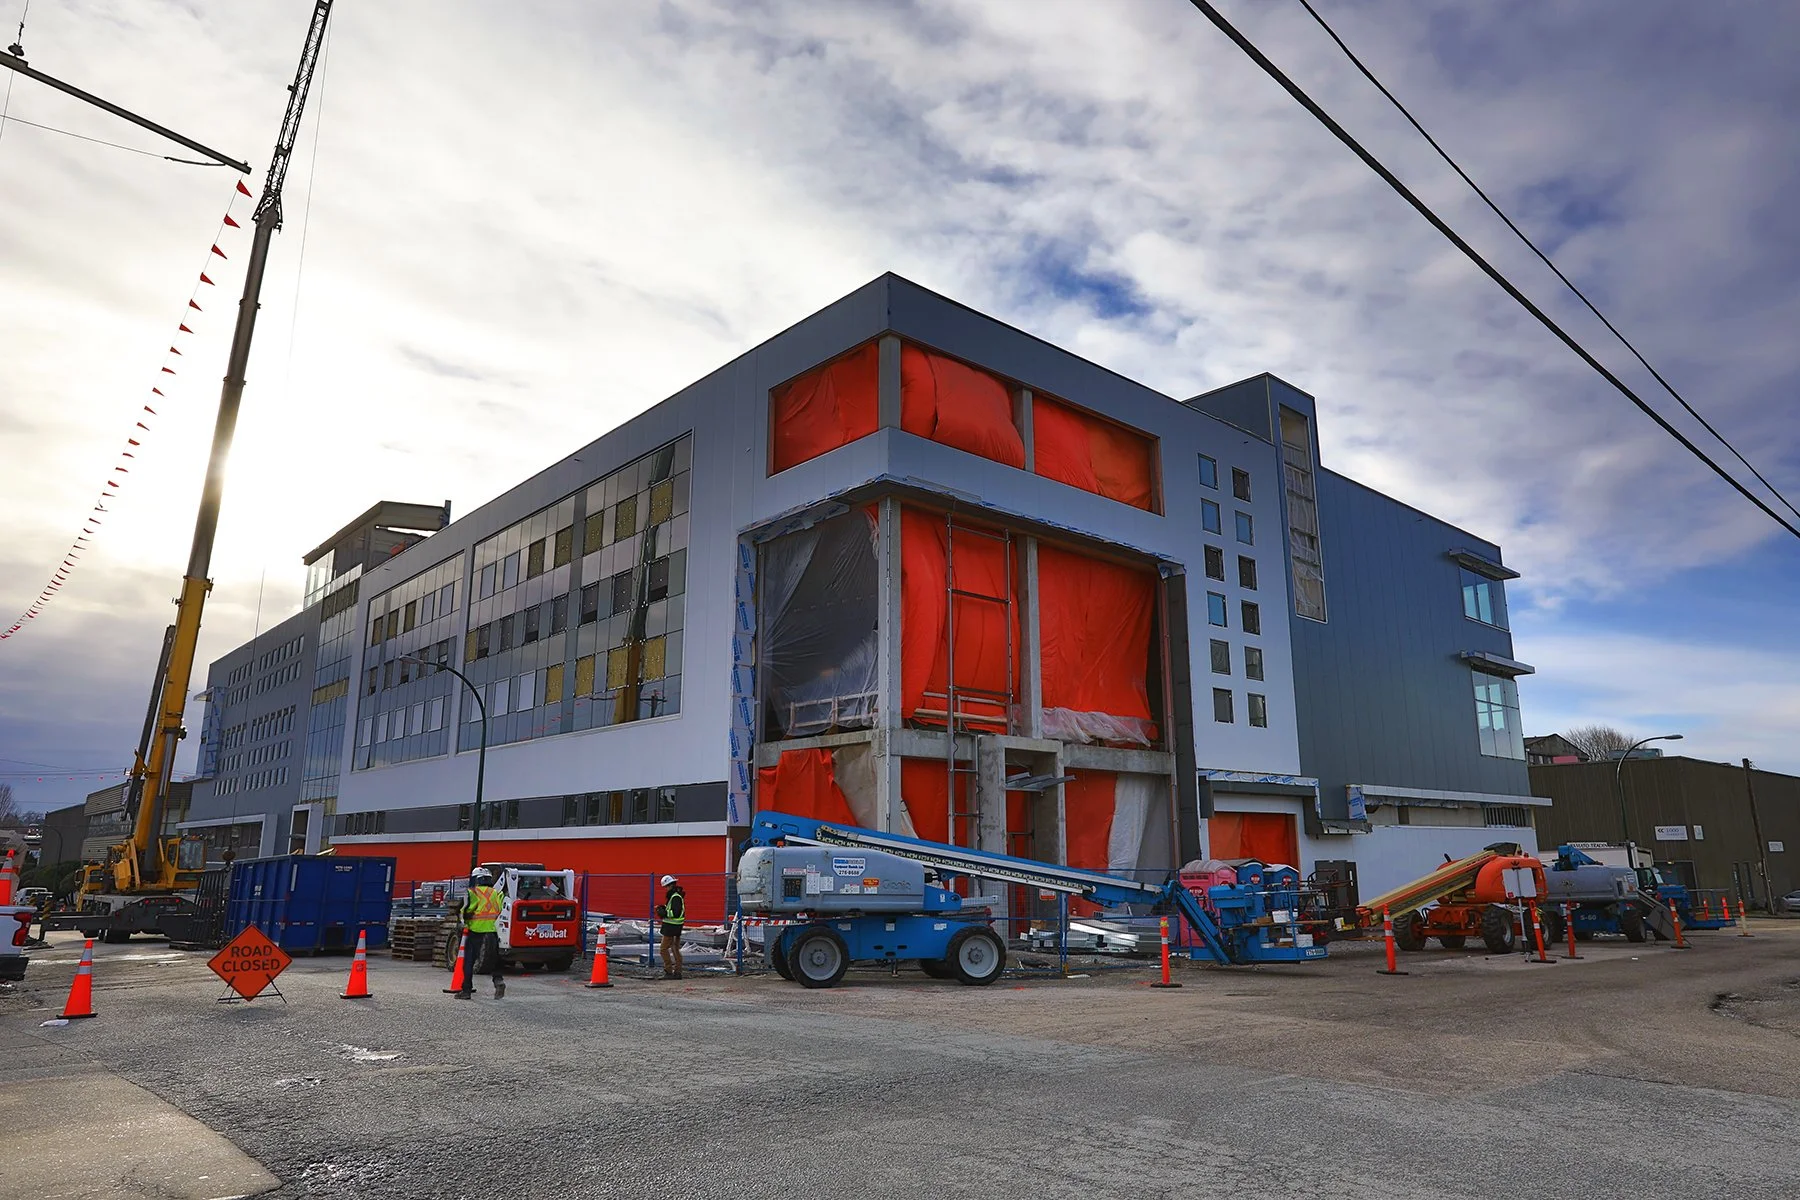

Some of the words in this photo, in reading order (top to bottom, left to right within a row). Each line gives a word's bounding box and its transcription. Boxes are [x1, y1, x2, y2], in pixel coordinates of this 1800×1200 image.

[539, 929, 568, 938] Bobcat
[231, 945, 272, 957] ROAD
[222, 959, 280, 972] CLOSED
